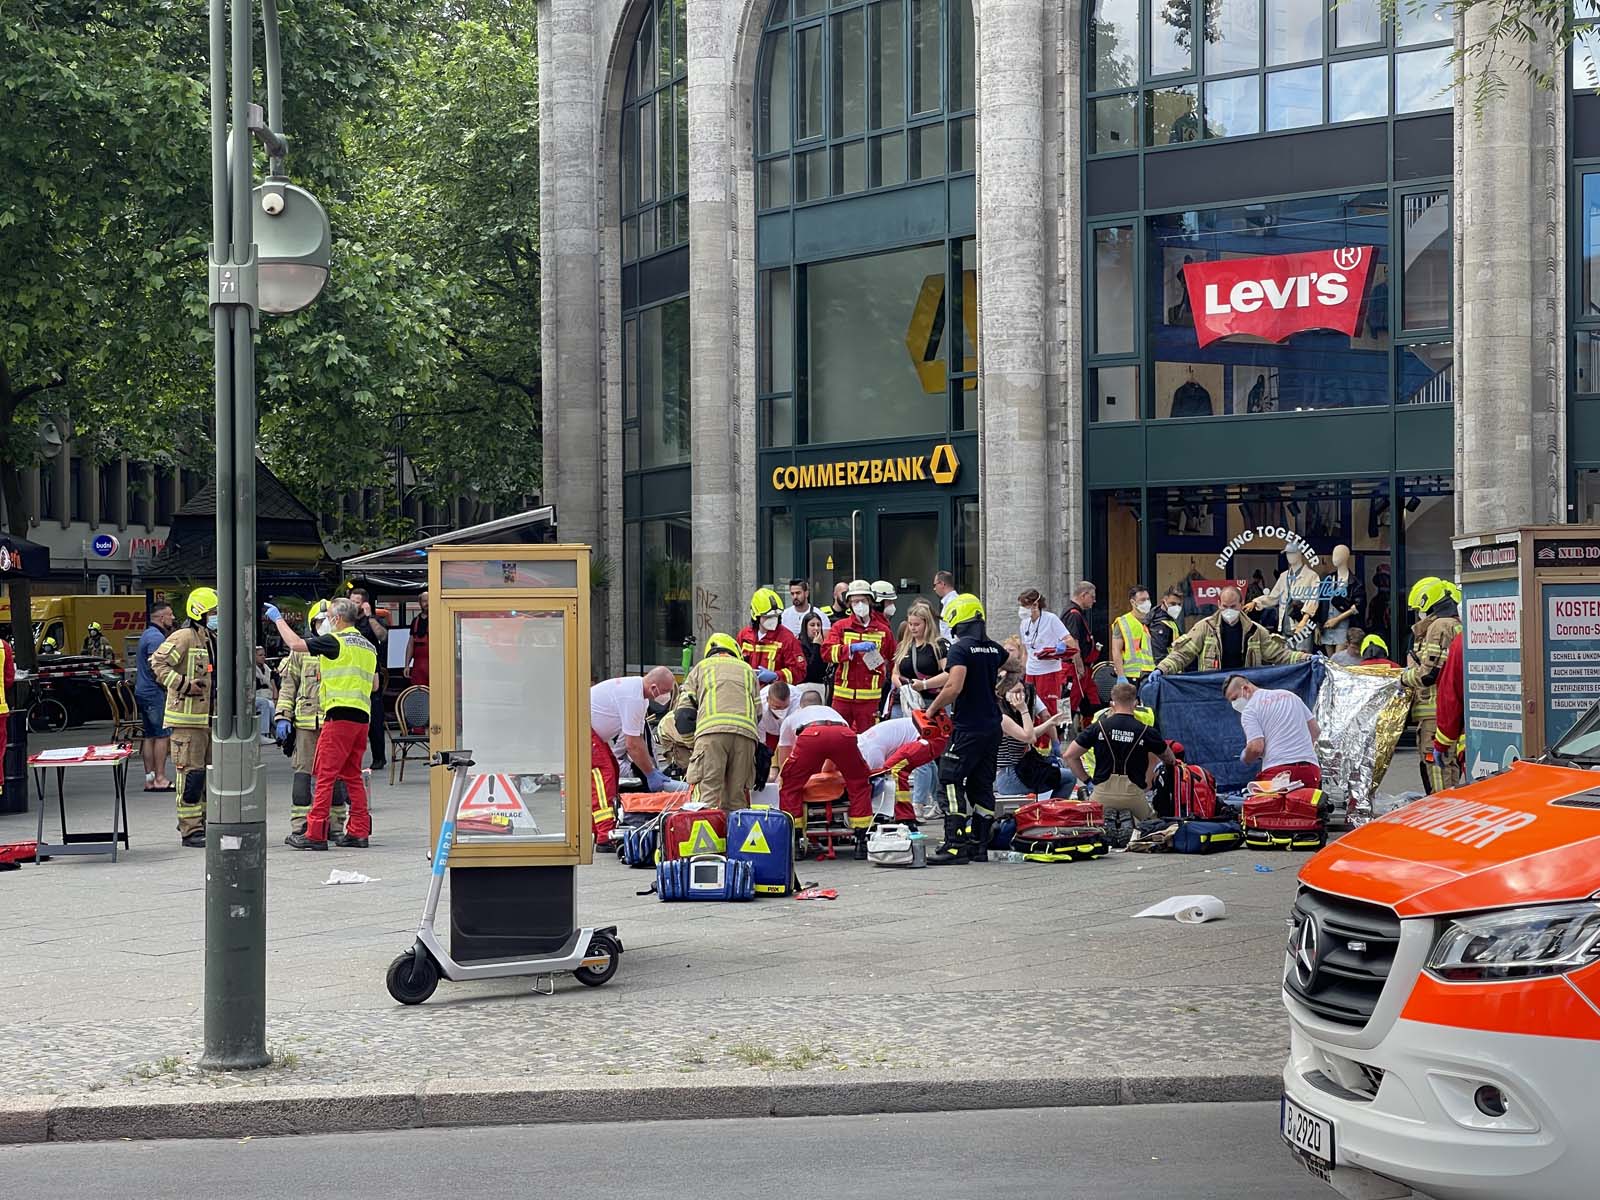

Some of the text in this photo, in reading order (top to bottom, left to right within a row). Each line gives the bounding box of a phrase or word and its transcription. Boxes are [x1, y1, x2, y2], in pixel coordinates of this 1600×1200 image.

[772, 456, 927, 490] COMMERZBANK
[1215, 525, 1320, 570] RIDING TOGETHER
[1558, 547, 1584, 559] NUR
[113, 611, 147, 630] DH
[1470, 602, 1516, 622] KOSTENLOSER
[1286, 619, 1317, 649] TURE
[439, 831, 453, 866] BIRD
[1287, 1106, 1321, 1152] B 2920
